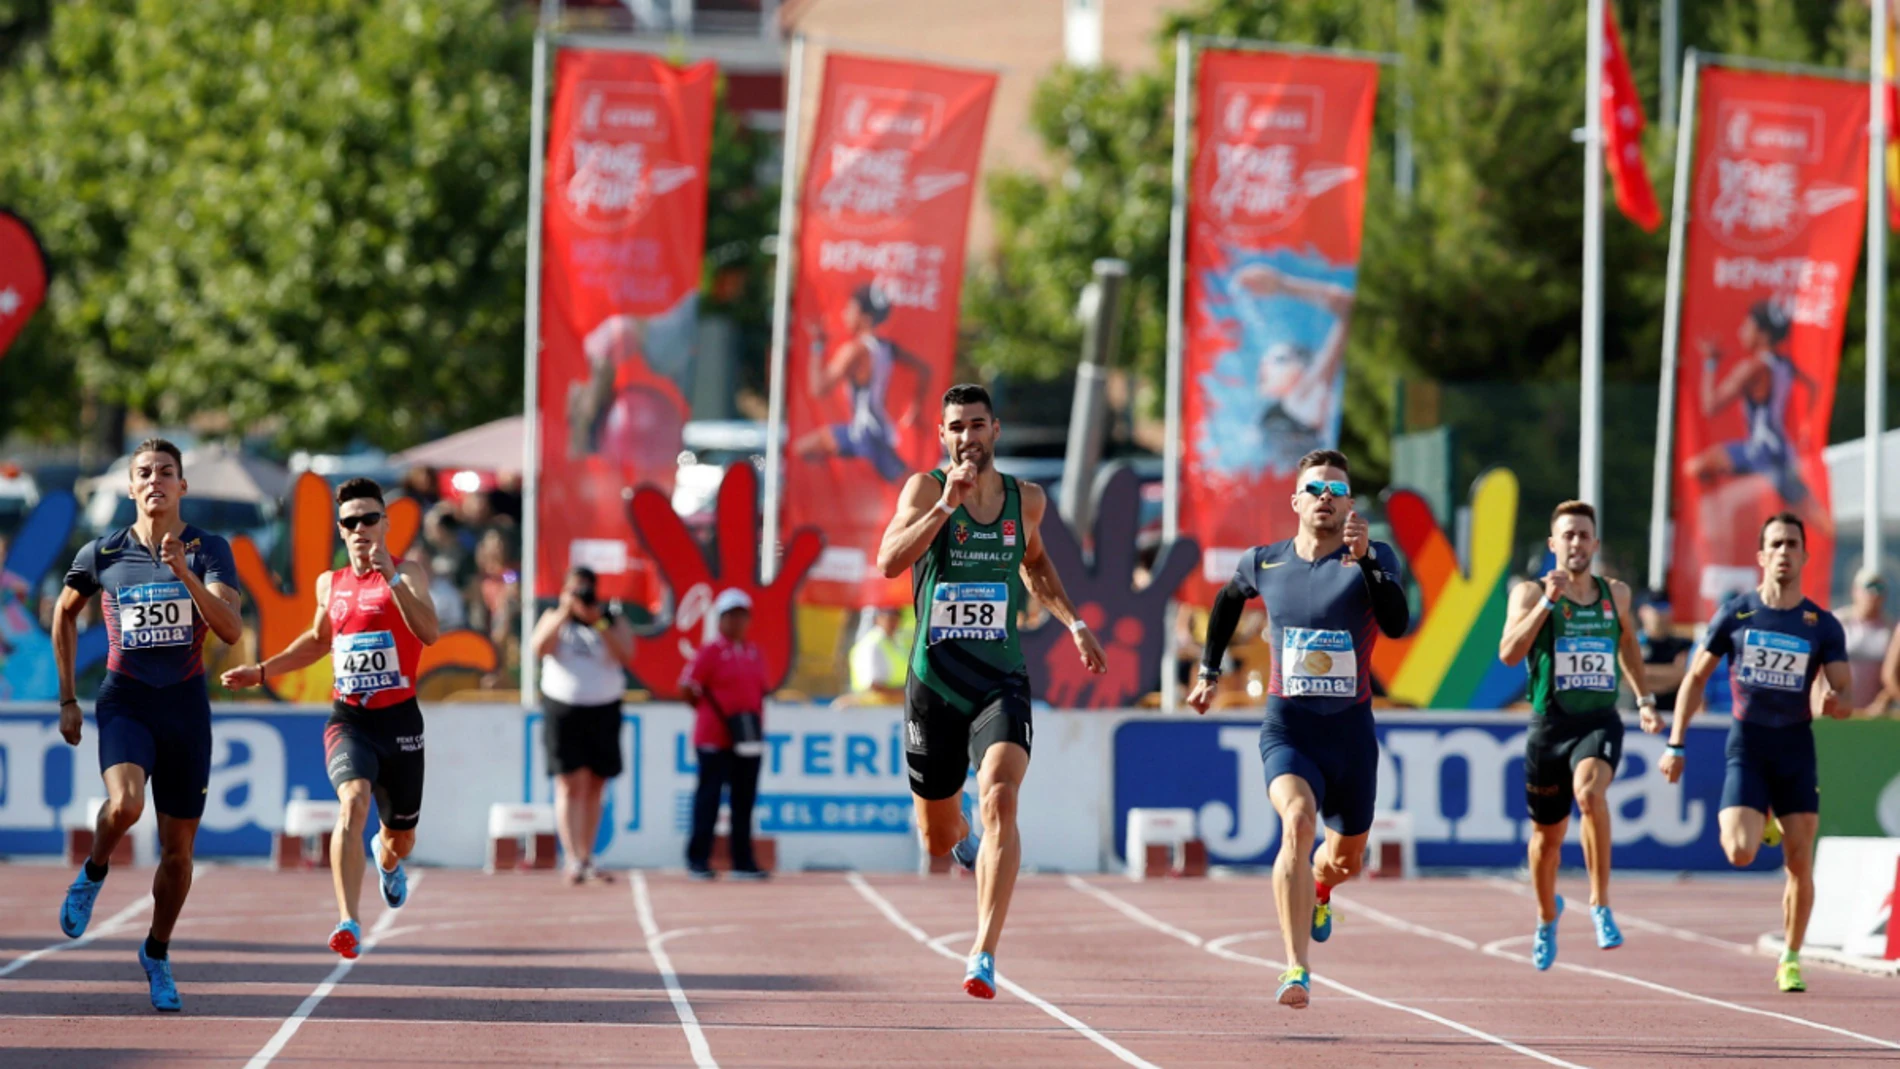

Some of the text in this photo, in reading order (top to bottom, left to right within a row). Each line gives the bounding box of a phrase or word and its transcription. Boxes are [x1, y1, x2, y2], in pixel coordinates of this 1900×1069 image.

[132, 602, 180, 628] 350
[945, 603, 995, 626] 158
[343, 651, 387, 674] 420
[1568, 654, 1606, 673] 162
[1755, 648, 1797, 672] 372
